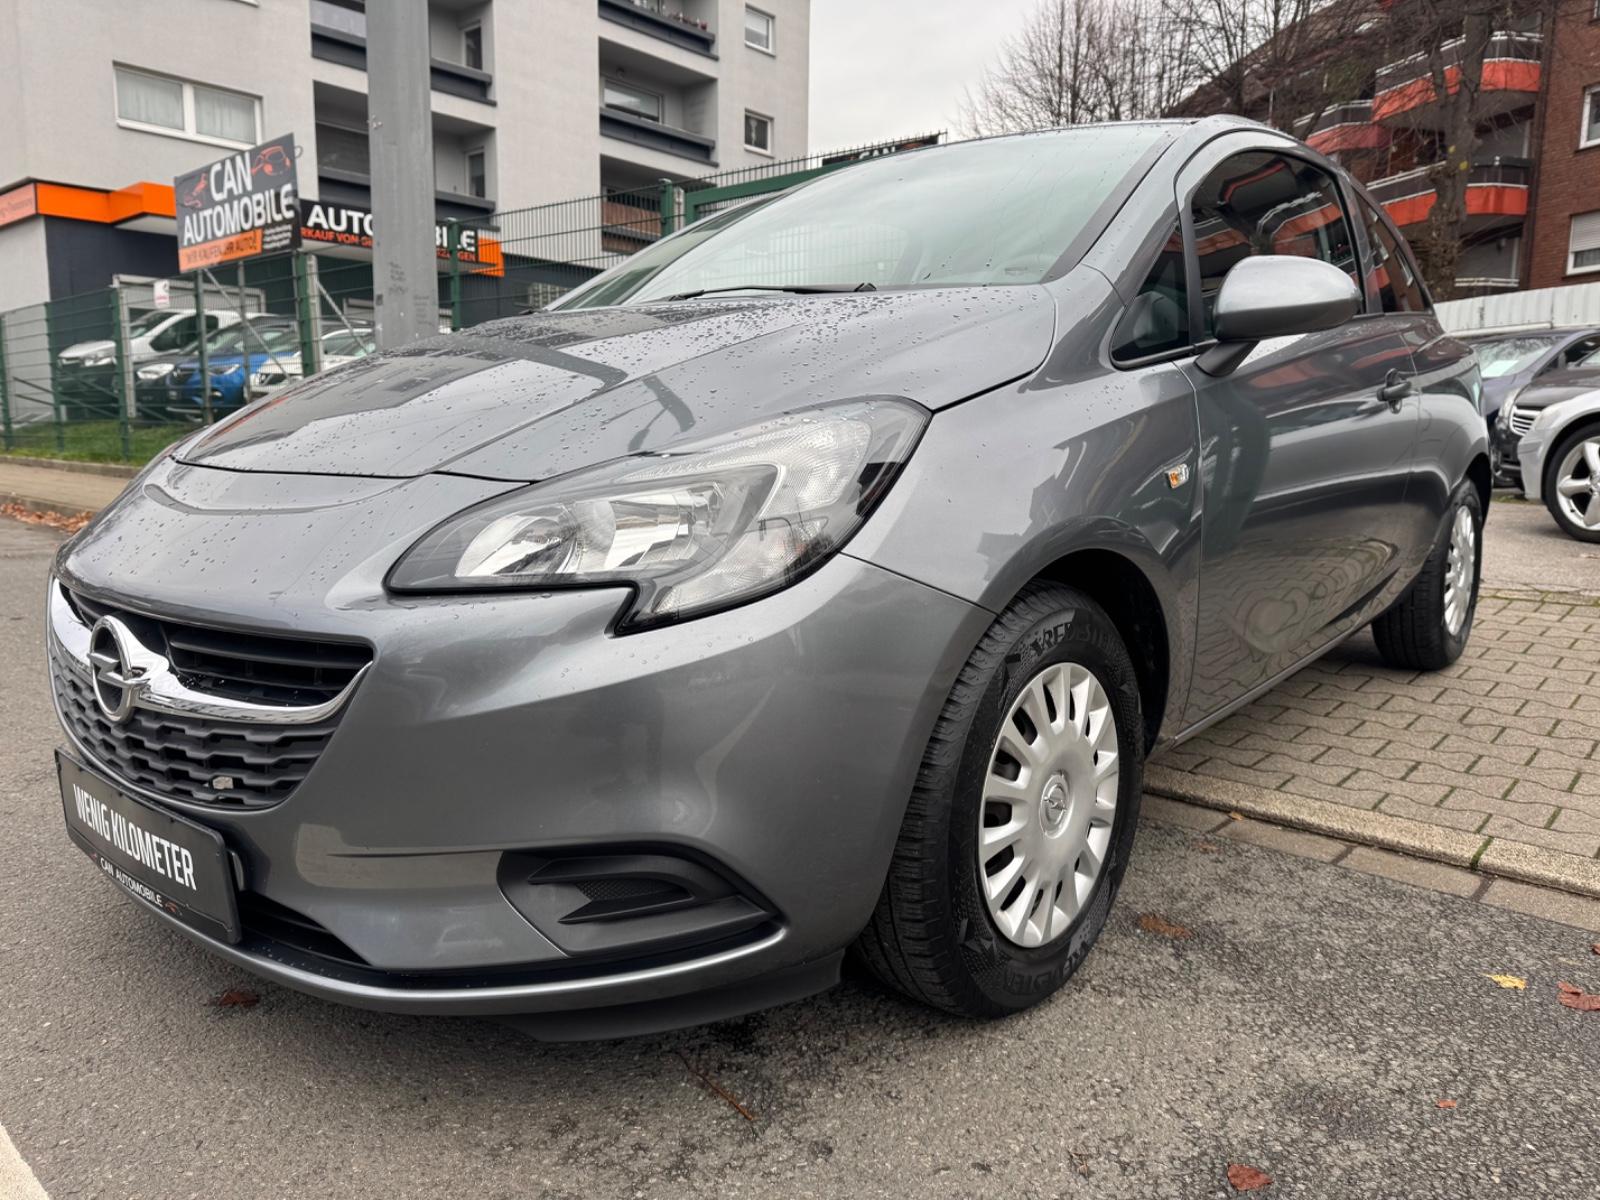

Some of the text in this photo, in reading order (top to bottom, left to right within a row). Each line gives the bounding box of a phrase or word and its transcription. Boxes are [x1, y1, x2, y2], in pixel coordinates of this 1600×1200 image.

[209, 151, 252, 201] CAN
[183, 183, 295, 246] AUTOMOBILE
[72, 783, 197, 891] WENIG KILOMETER
[100, 857, 164, 908] CAN AUTOMOBILE
